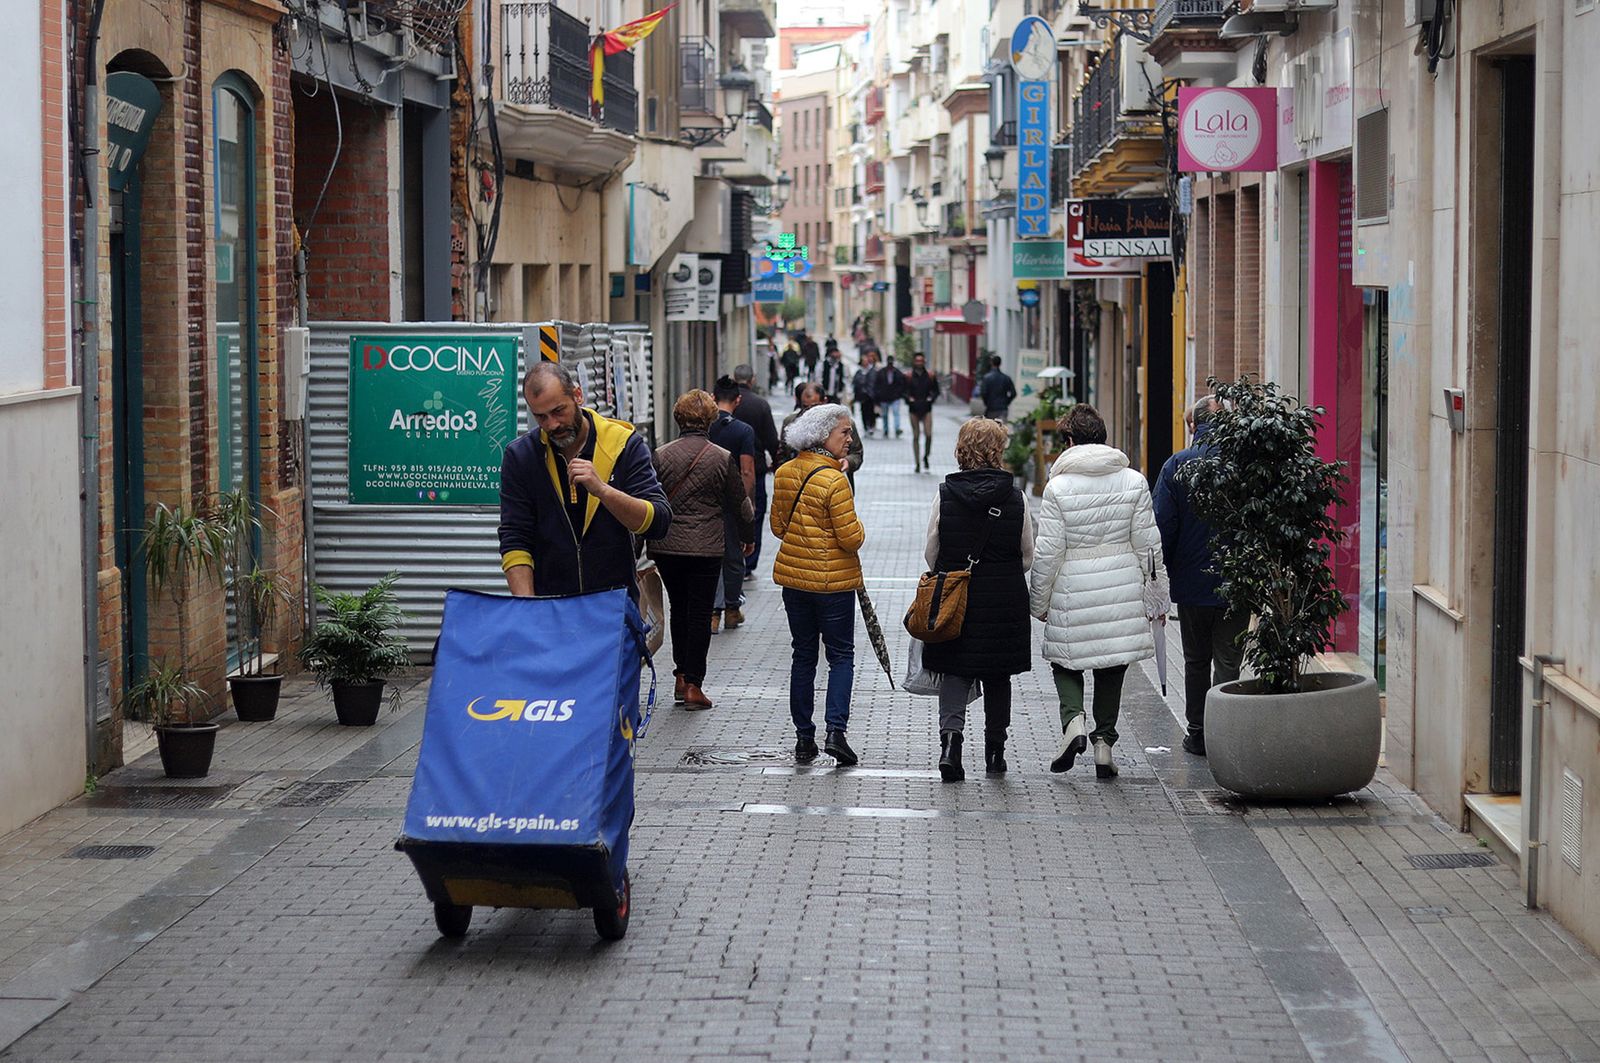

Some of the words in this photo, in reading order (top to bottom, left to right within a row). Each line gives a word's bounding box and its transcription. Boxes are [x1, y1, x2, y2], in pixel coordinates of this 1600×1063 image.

[1195, 109, 1248, 134] Lala
[1022, 85, 1046, 232] GIRLADY
[363, 345, 505, 371] DCOCINA
[406, 431, 459, 439] CUCINE
[363, 464, 387, 472] TLFN:
[428, 465, 463, 473] 915/620
[378, 473, 488, 481] WWW.DCOCINAHUELVA.ES
[366, 480, 500, 489] DCOCINA@DCOCINAHUELVA.ES
[523, 699, 577, 722] GLS
[426, 813, 580, 833] www.gls-spain.es
